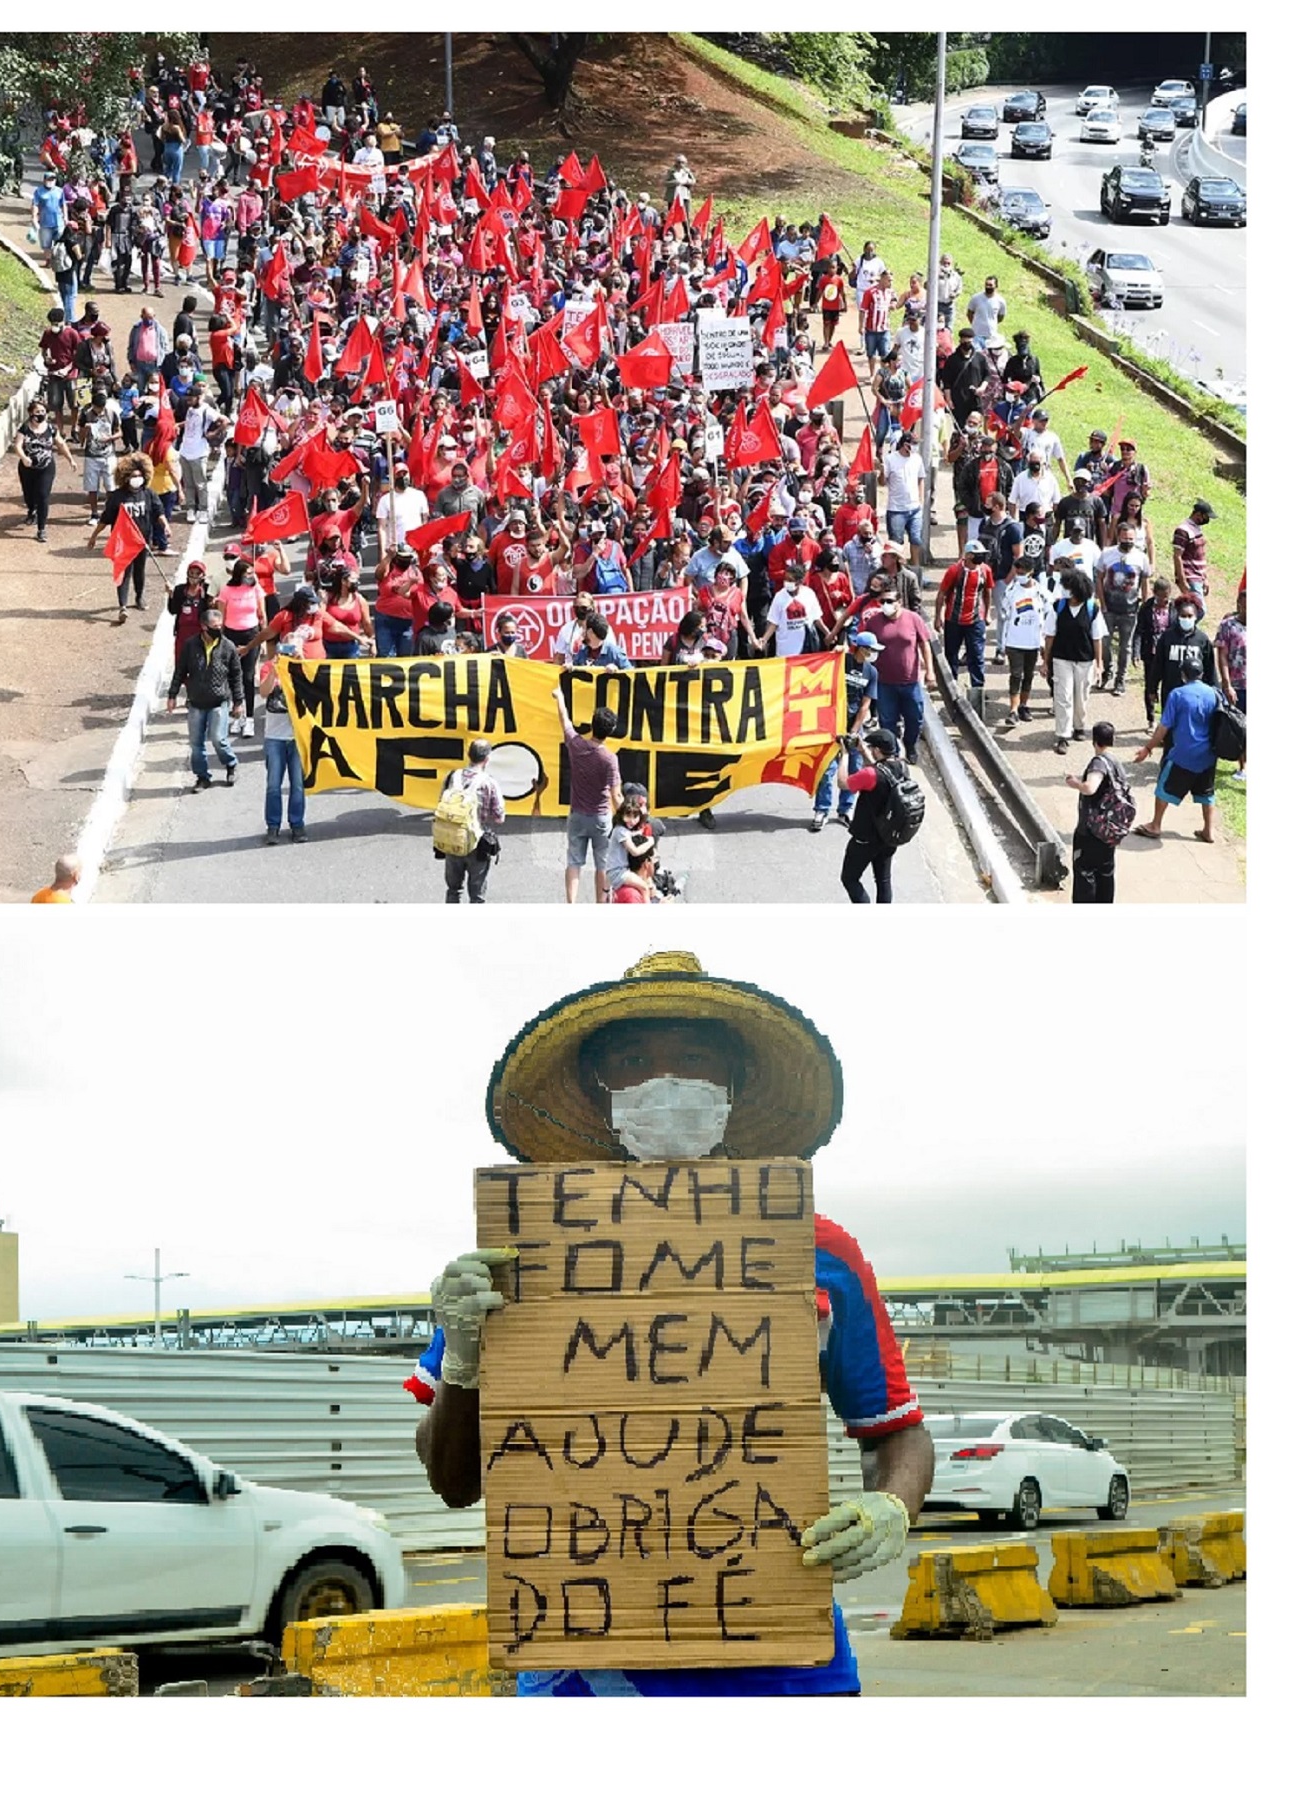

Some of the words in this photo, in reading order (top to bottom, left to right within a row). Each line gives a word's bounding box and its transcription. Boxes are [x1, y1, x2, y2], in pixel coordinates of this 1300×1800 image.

[377, 407, 394, 417] G6
[124, 500, 146, 517] TST
[546, 592, 685, 629] OCPAÇÃO
[1168, 644, 1201, 662] MTST
[287, 659, 518, 733] MARCHA
[559, 665, 768, 744] CONTRA
[303, 724, 364, 788] A
[478, 1164, 805, 1235] TENHO
[509, 1236, 776, 1303] FOME
[562, 1312, 772, 1389] MEM
[486, 1401, 787, 1482] AJUDE
[503, 1479, 804, 1562] OBRIGA
[503, 1571, 613, 1653] DO
[656, 1553, 762, 1642] FÉ
